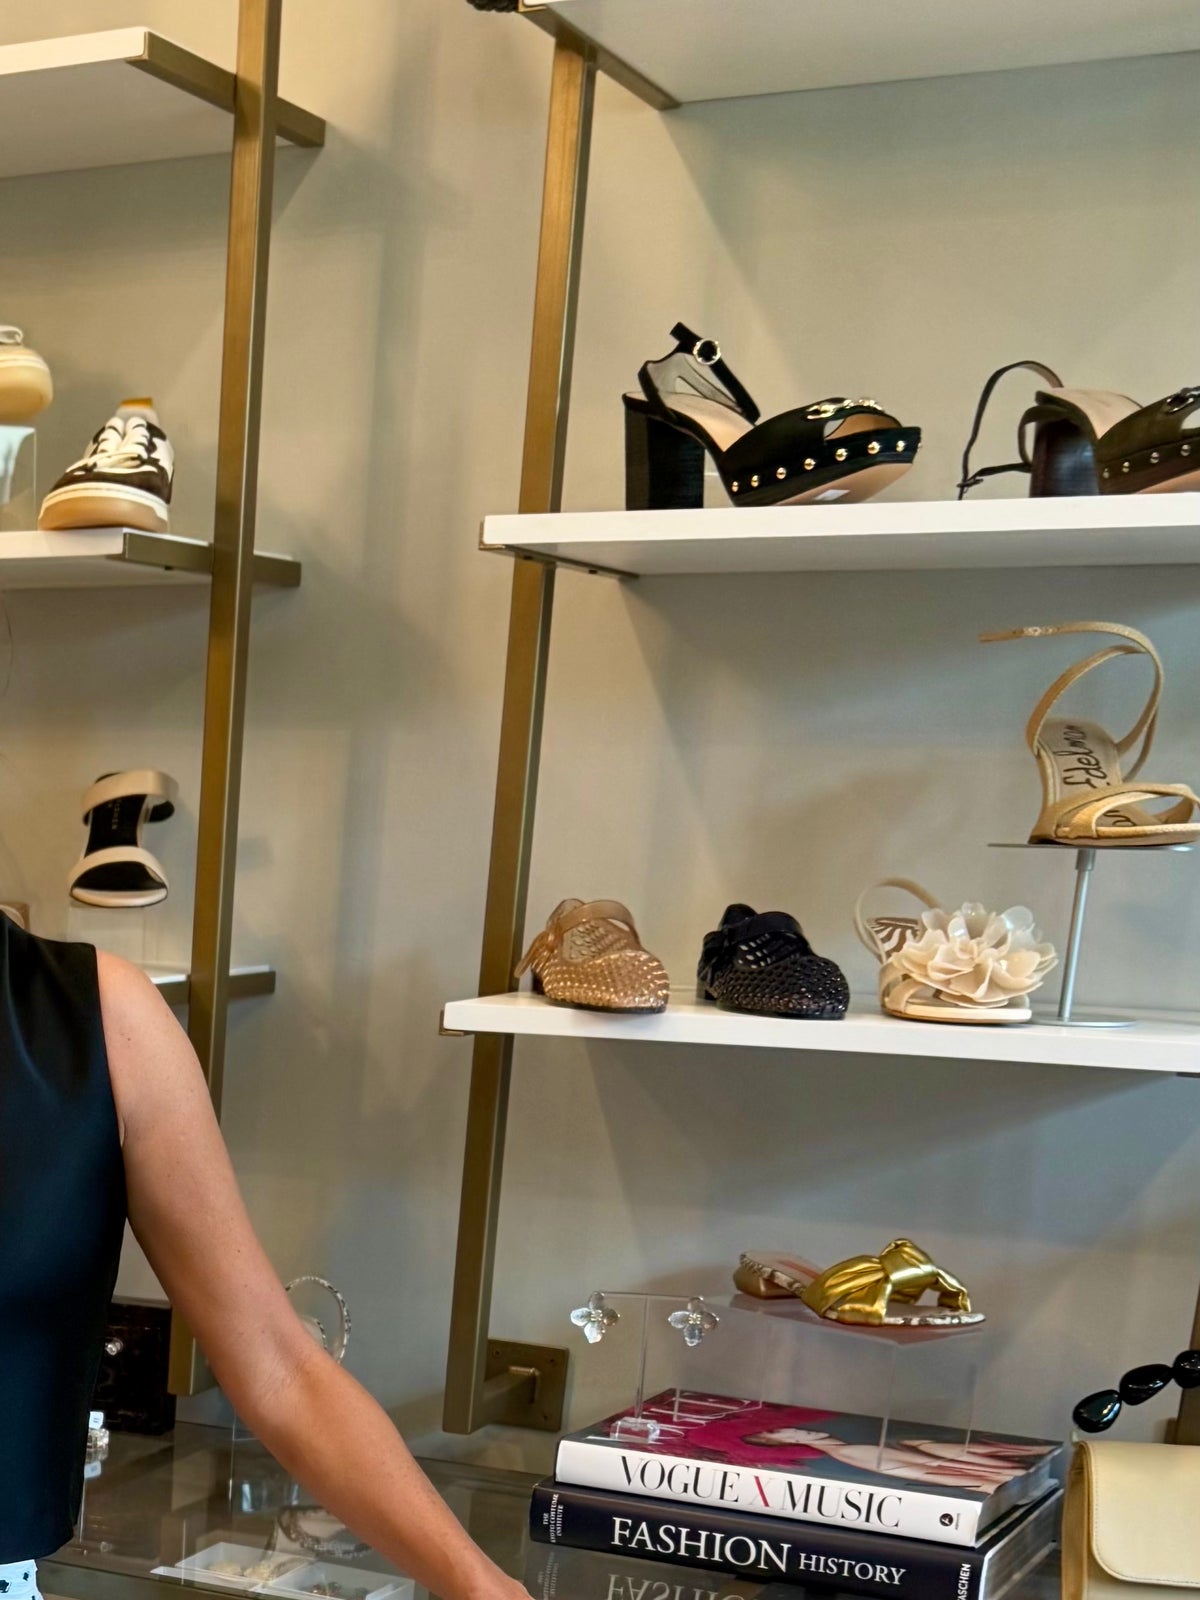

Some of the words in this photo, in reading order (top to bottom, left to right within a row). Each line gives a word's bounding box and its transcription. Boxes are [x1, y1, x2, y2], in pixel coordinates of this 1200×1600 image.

[550, 1493, 559, 1524] COSTUME
[620, 1455, 741, 1503] VOGUE
[749, 1475, 774, 1509] X
[780, 1479, 902, 1528] MUSIC
[556, 1504, 564, 1537] INSTITUTE
[611, 1517, 792, 1573] FASHION
[799, 1553, 906, 1585] HISTORY
